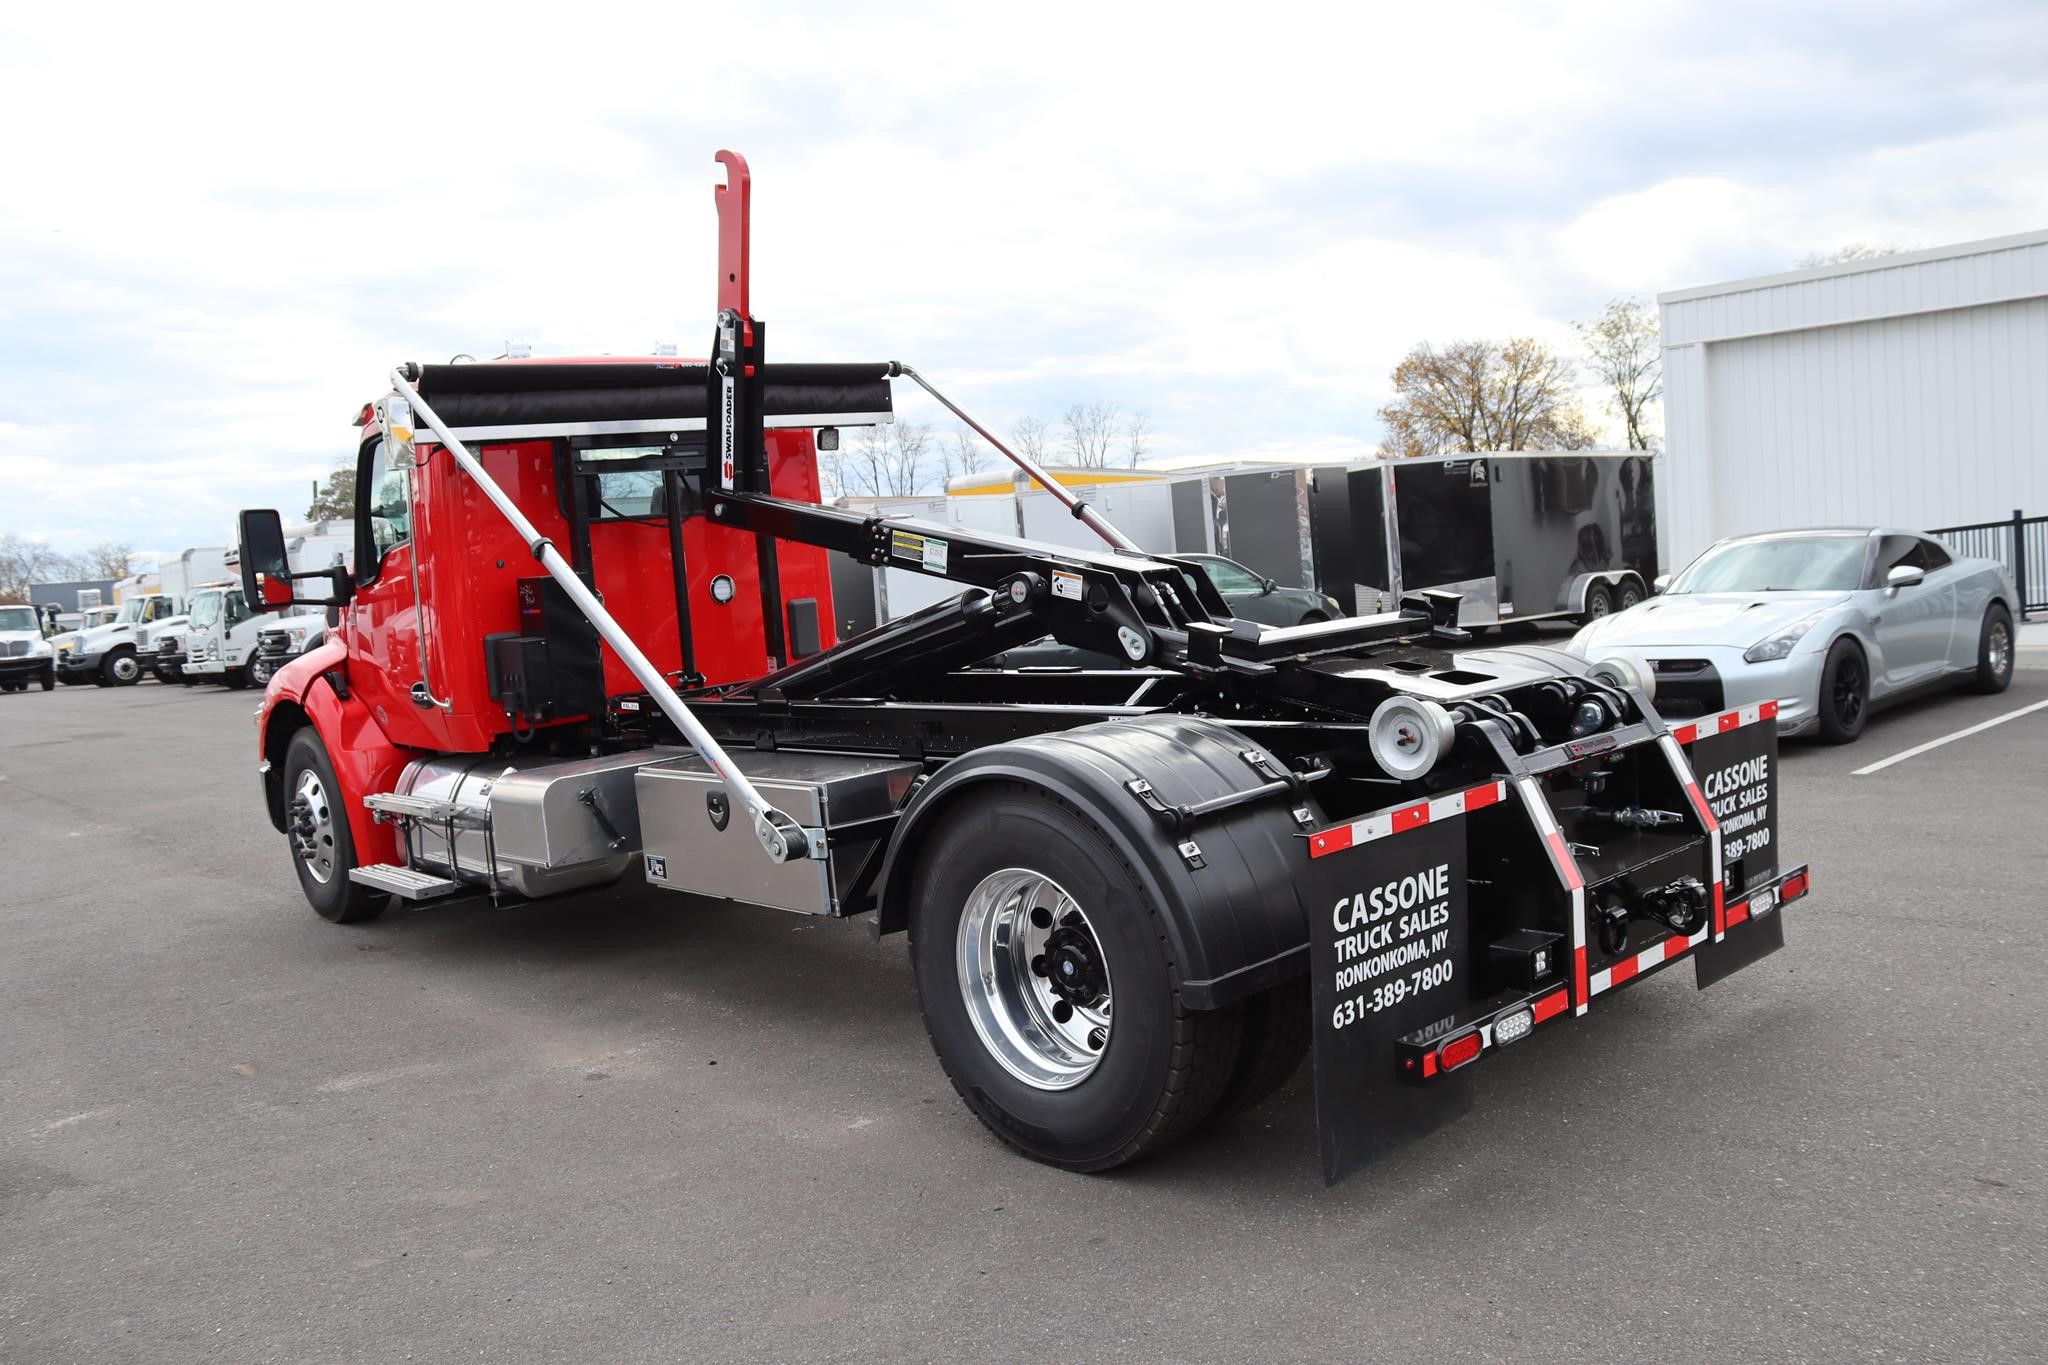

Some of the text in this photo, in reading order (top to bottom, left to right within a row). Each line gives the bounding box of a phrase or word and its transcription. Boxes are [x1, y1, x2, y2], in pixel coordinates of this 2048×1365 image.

[1704, 754, 1768, 800] CASSONE
[1710, 783, 1768, 818] RUCK SALES
[1757, 805, 1768, 821] NY
[1724, 828, 1770, 858] 389-7800
[1333, 864, 1449, 933] CASSONE
[1334, 901, 1449, 963] TRUCK SALES
[1335, 929, 1449, 993] RONKONKOMA, NY
[1333, 959, 1453, 1030] 631-389-7800
